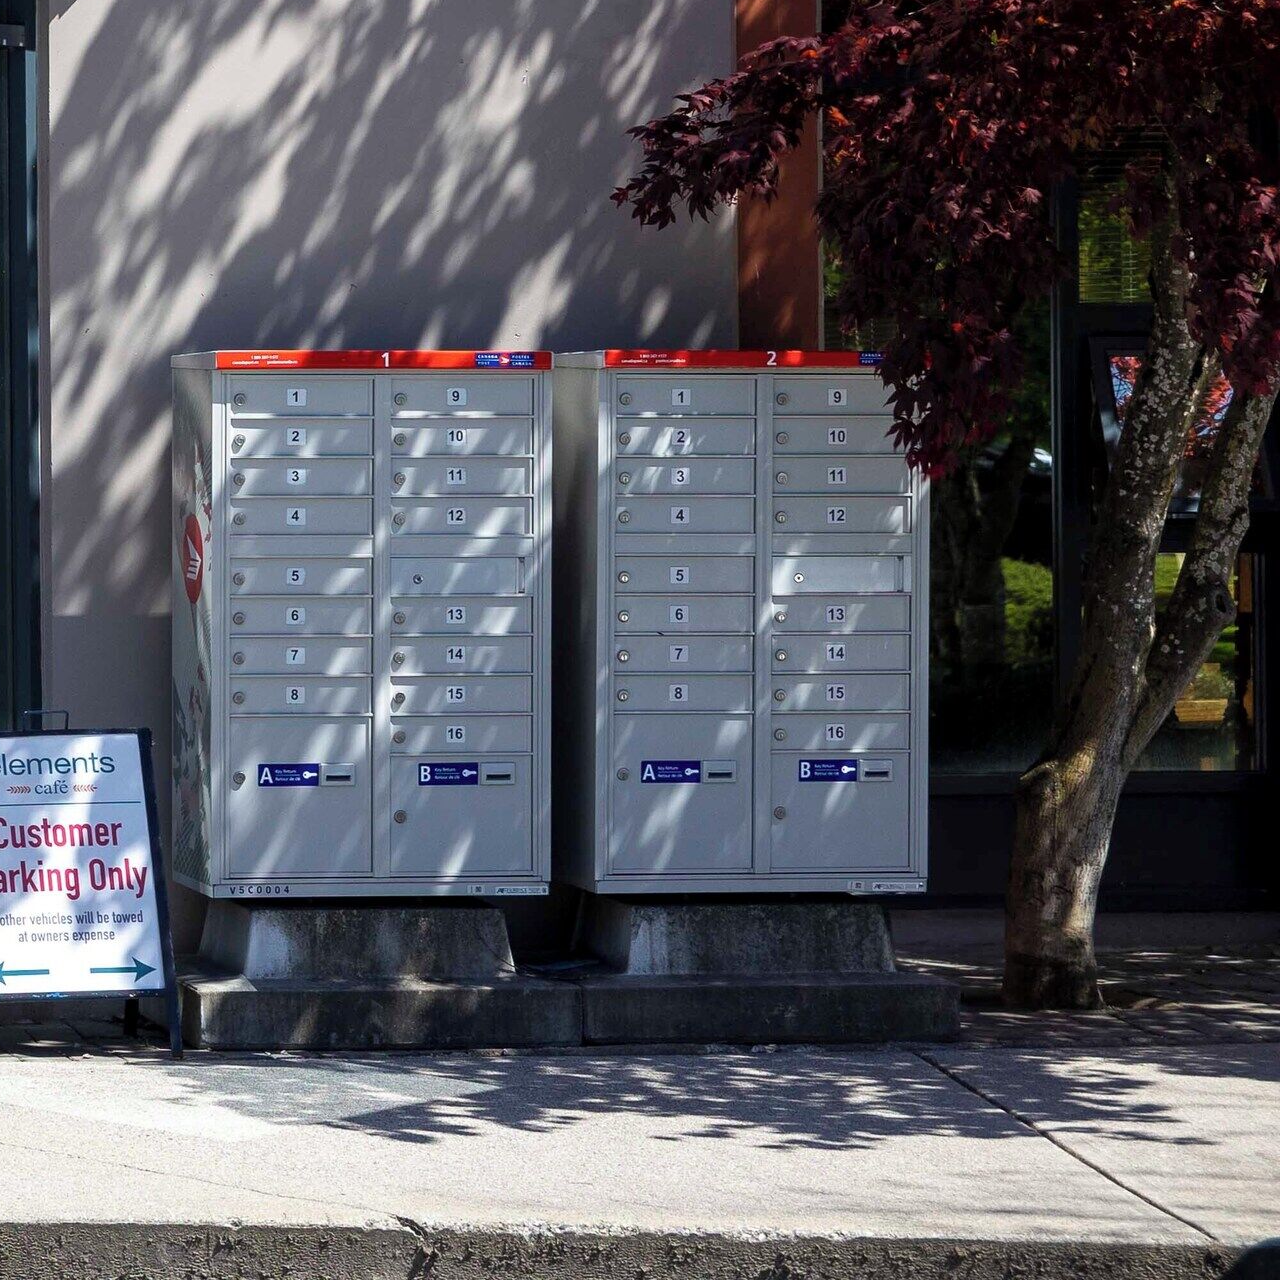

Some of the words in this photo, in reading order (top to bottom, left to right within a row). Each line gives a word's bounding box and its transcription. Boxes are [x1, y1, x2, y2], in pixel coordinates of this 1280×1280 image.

[381, 352, 389, 367] 1
[766, 351, 777, 366] 2
[292, 390, 299, 403] 1
[452, 390, 460, 402] 9
[677, 390, 684, 404] 1
[833, 390, 842, 404] 9
[291, 430, 300, 442] 2
[448, 430, 464, 442] 10
[676, 430, 685, 444] 2
[829, 430, 846, 443] 10
[291, 470, 300, 482] 3
[448, 469, 462, 481] 11
[675, 469, 685, 483] 3
[829, 469, 843, 482] 11
[291, 509, 300, 522] 4
[448, 509, 464, 521] 12
[675, 508, 685, 522] 4
[828, 509, 845, 522] 12
[291, 570, 300, 582] 5
[675, 569, 684, 582] 5
[291, 609, 299, 621] 6
[447, 608, 463, 621] 13
[675, 608, 684, 621] 6
[828, 608, 845, 621] 13
[290, 649, 299, 661] 7
[448, 648, 463, 660] 14
[674, 647, 683, 660] 7
[828, 646, 845, 660] 14
[290, 688, 299, 701] 8
[447, 688, 463, 700] 15
[674, 686, 683, 700] 8
[828, 686, 845, 699] 15
[447, 727, 463, 740] 16
[827, 726, 844, 739] 16
[260, 766, 273, 784] A
[420, 765, 431, 782] B
[642, 763, 656, 781] A
[800, 761, 811, 779] B
[34, 779, 69, 796] café
[89, 857, 148, 899] Only
[0, 914, 26, 927] other
[29, 912, 73, 926] vehicles
[75, 911, 94, 925] will
[97, 911, 110, 924] be
[112, 910, 144, 924] towed
[18, 931, 28, 943] at
[31, 931, 69, 942] owners
[72, 929, 116, 944] expense
